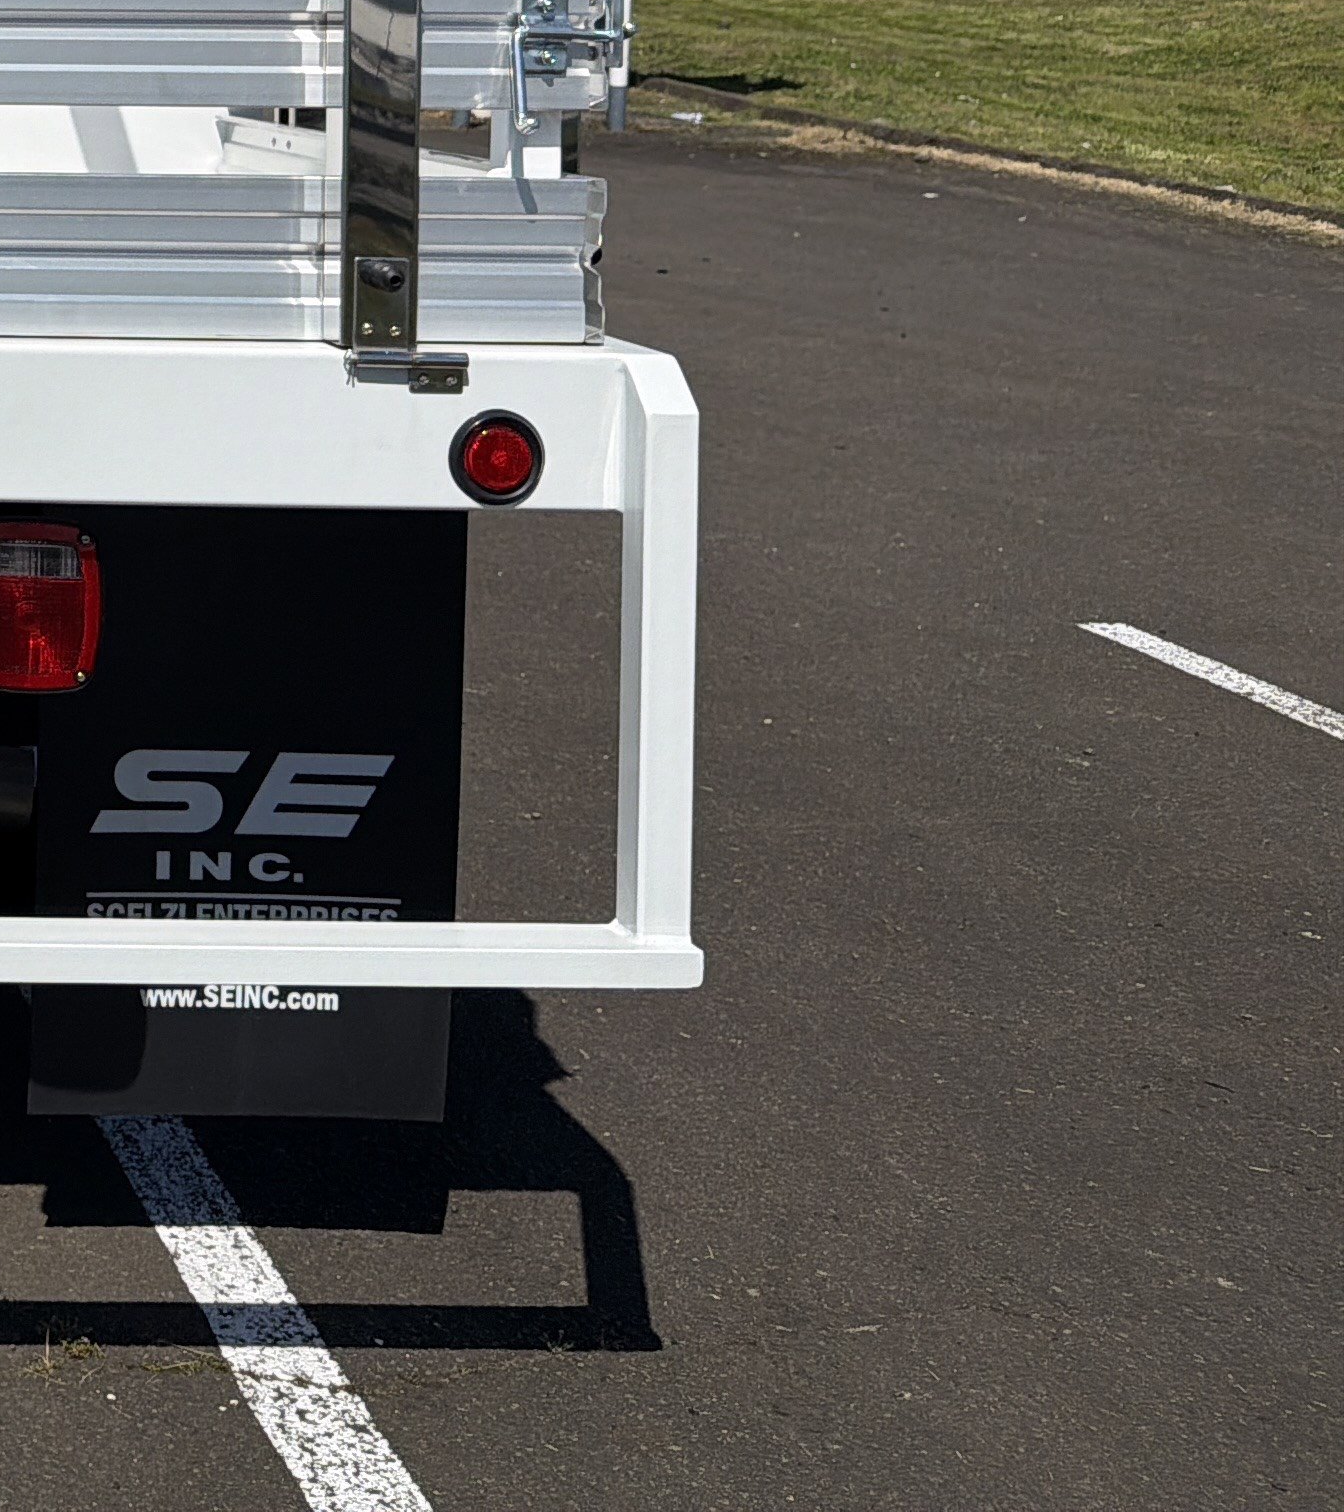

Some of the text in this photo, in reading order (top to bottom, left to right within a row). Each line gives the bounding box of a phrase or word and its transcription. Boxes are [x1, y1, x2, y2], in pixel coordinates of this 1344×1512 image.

[89, 748, 396, 838] SE
[155, 849, 304, 884] INC.
[139, 984, 340, 1012] www.SEINC.com
